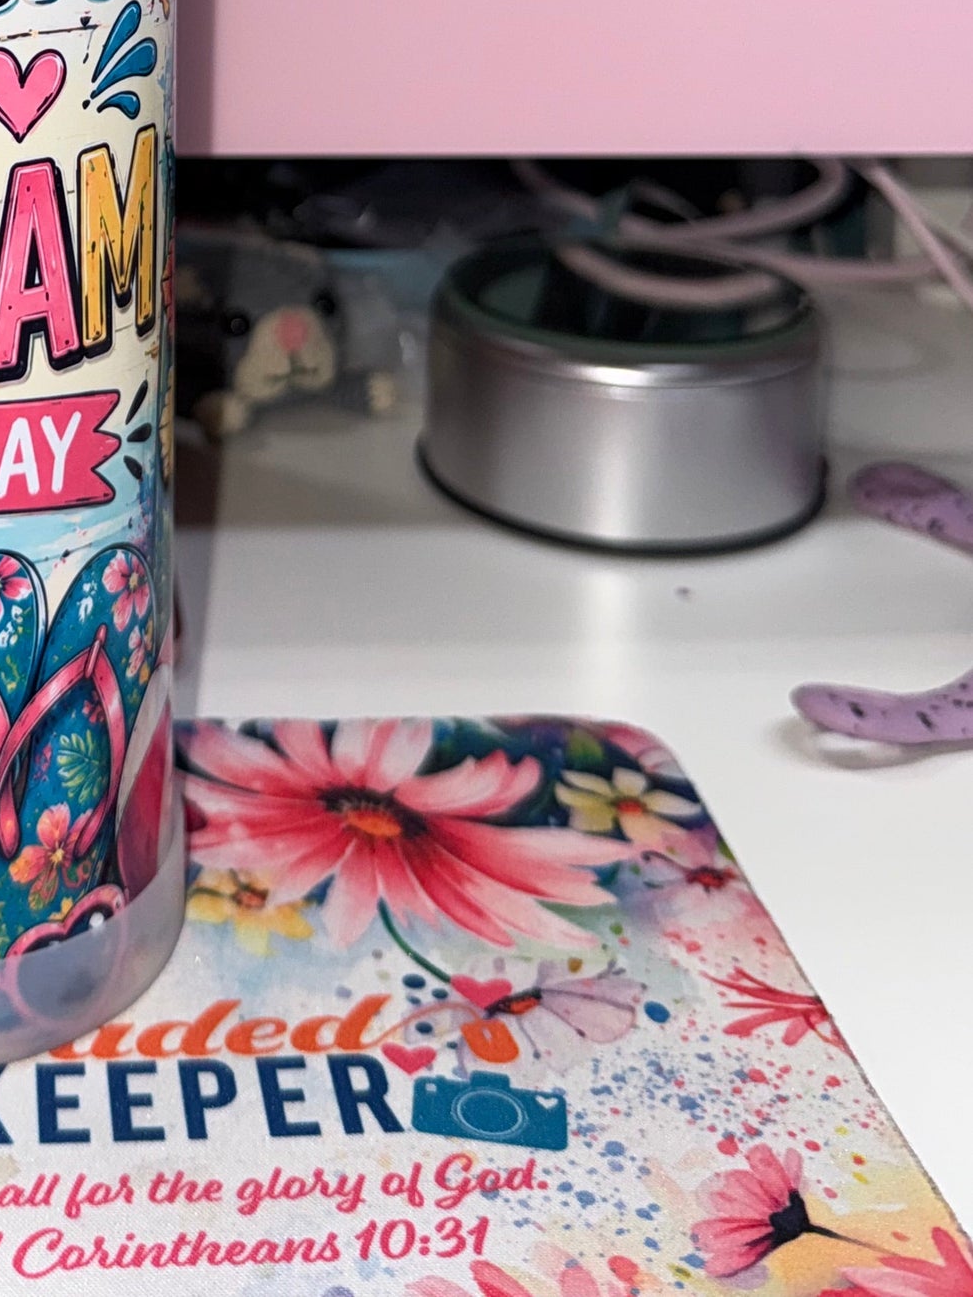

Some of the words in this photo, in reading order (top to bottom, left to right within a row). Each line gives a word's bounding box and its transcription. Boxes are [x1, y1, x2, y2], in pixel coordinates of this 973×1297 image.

[64, 1170, 137, 1220] for
[148, 1169, 224, 1203] the
[235, 1167, 367, 1216] glory
[380, 1160, 425, 1220] of
[433, 1152, 551, 1207] God.
[11, 1225, 340, 1280] Corintheans
[354, 1215, 491, 1262] 10:31
